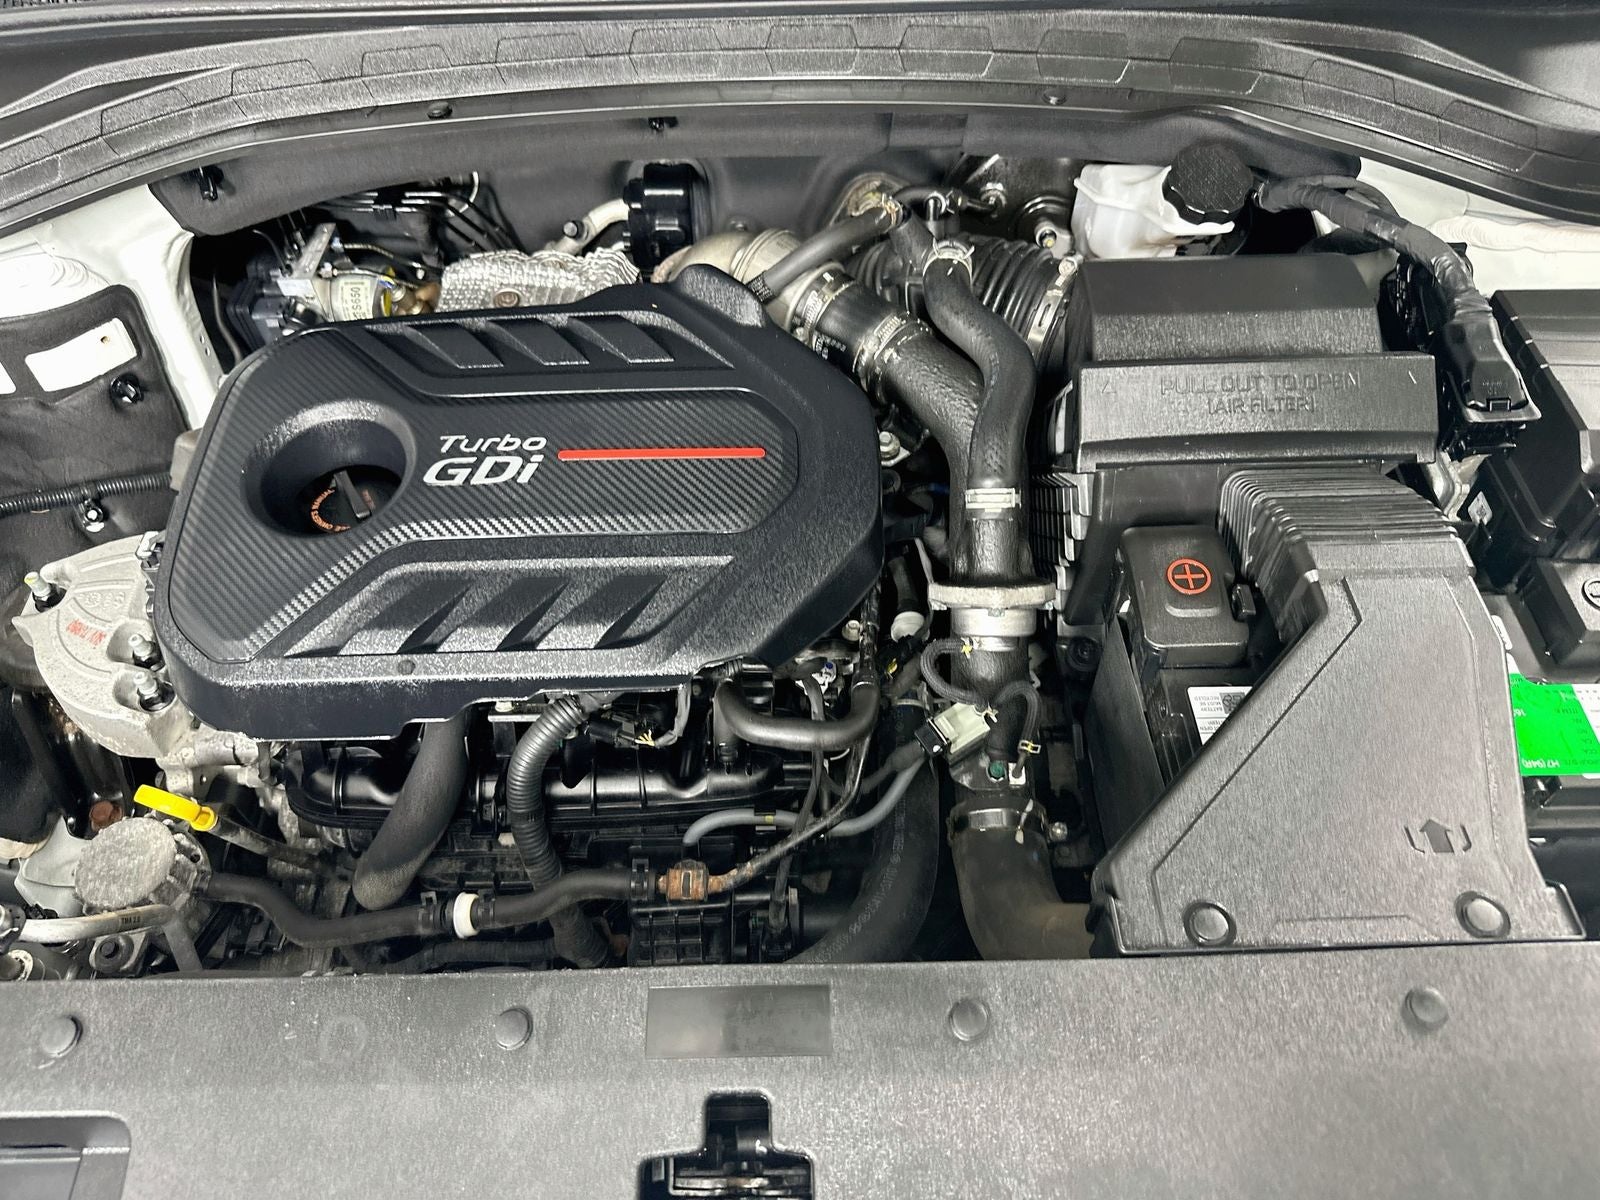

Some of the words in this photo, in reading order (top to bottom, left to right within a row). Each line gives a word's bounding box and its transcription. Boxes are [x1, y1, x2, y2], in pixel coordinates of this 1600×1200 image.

[1161, 374, 1217, 396] PULL
[1220, 374, 1265, 393] OUT
[1268, 373, 1297, 392] TO
[1303, 371, 1361, 391] OPEN
[440, 434, 547, 453] Turbo
[422, 454, 545, 486] GDi
